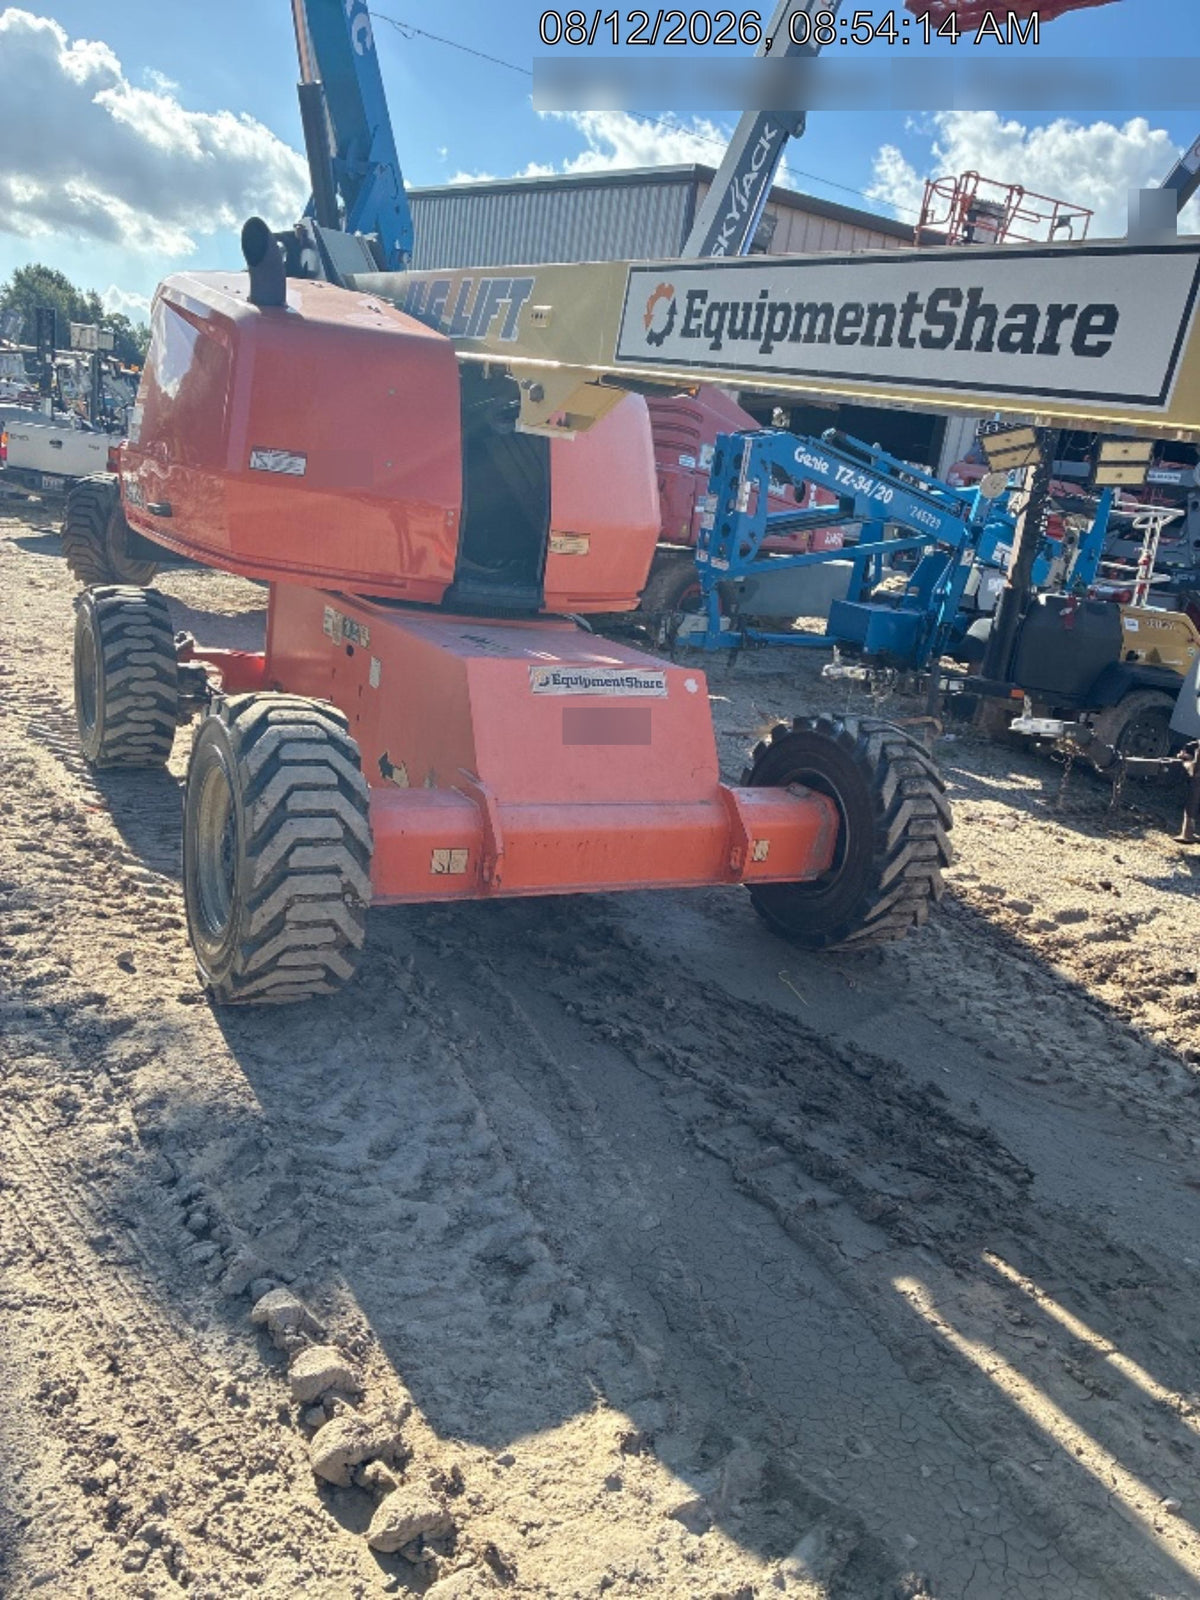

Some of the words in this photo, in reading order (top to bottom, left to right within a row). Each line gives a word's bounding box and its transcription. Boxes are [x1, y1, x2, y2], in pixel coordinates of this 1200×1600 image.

[448, 276, 536, 342] LIFT
[680, 287, 1120, 358] EquipmentShare
[794, 446, 830, 476] Genie
[834, 465, 894, 505] TZ-34/20
[551, 673, 664, 690] EquipmentShare
